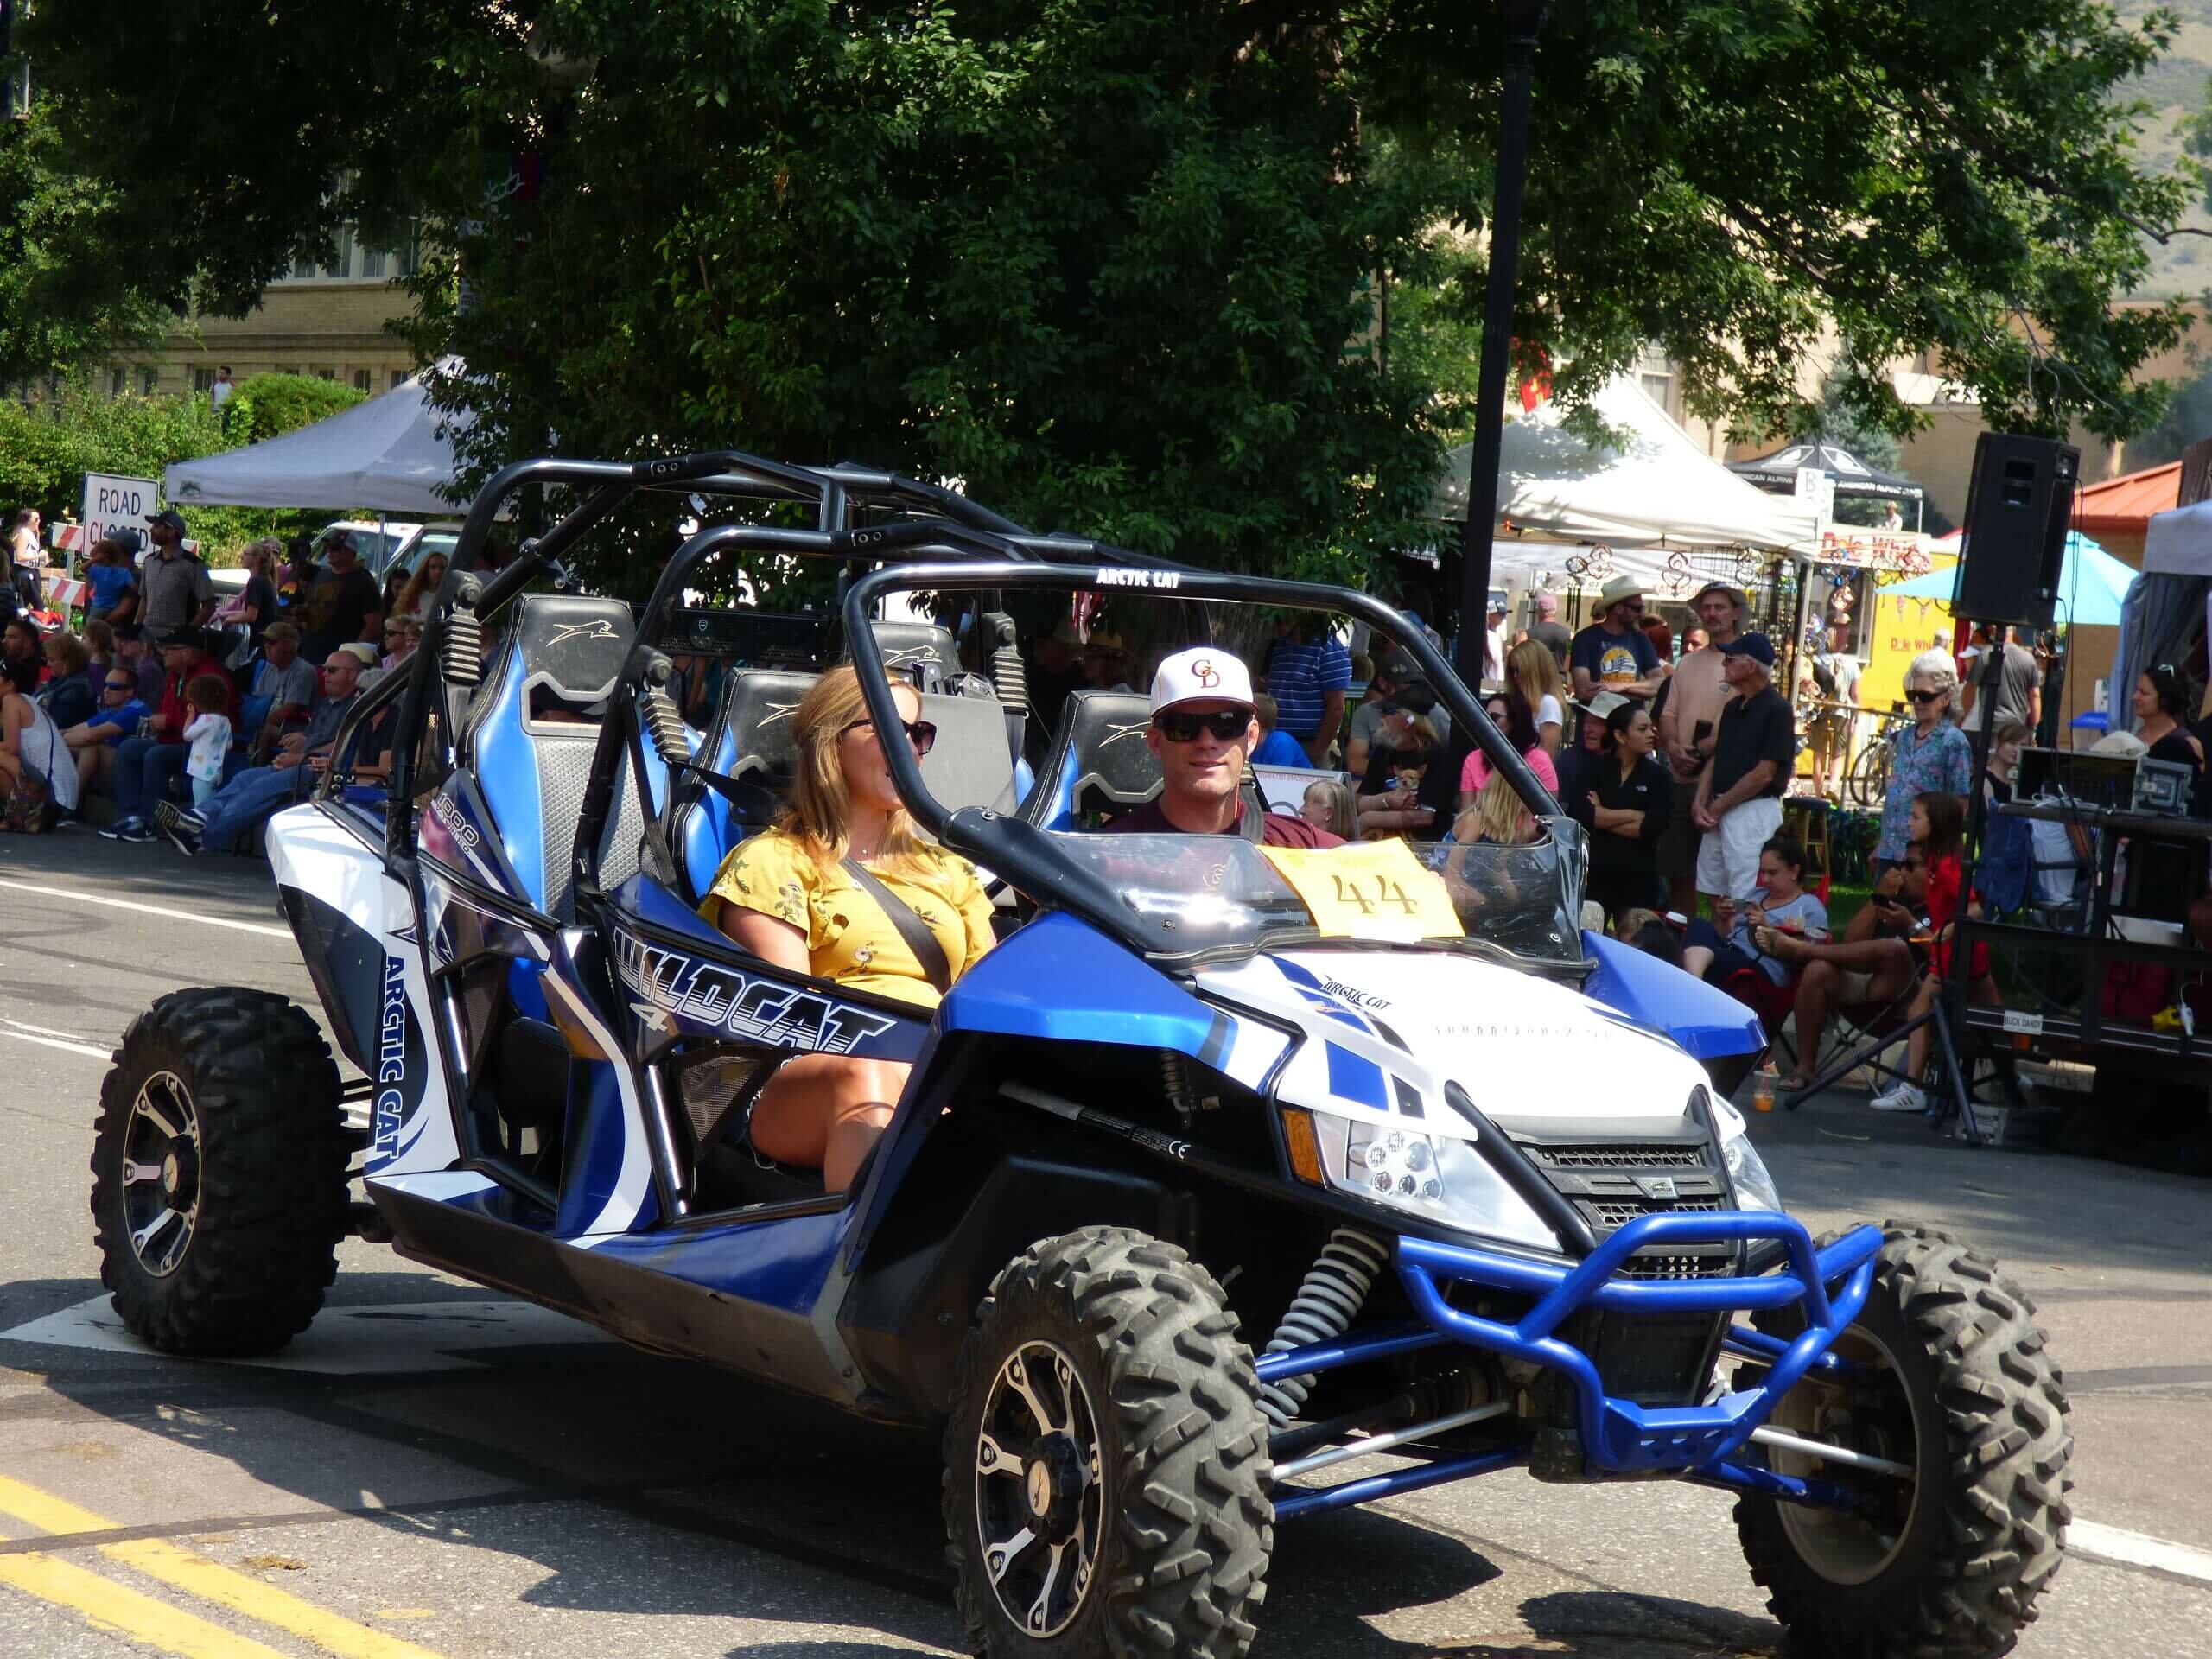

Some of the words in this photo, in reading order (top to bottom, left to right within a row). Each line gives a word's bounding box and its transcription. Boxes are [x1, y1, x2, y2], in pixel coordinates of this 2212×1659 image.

[99, 487, 141, 516] ROAD
[1096, 568, 1149, 587] ARCTIC
[1153, 571, 1180, 588] CAT
[438, 793, 479, 847] 1000
[1331, 874, 1418, 915] 44
[613, 926, 897, 1053] WILDCAT
[1321, 981, 1368, 1002] ARCTIC
[1365, 996, 1393, 1010] CAT
[380, 954, 405, 1084] ARCTIC
[629, 1001, 671, 1033] 4
[375, 1090, 403, 1160] CAT
